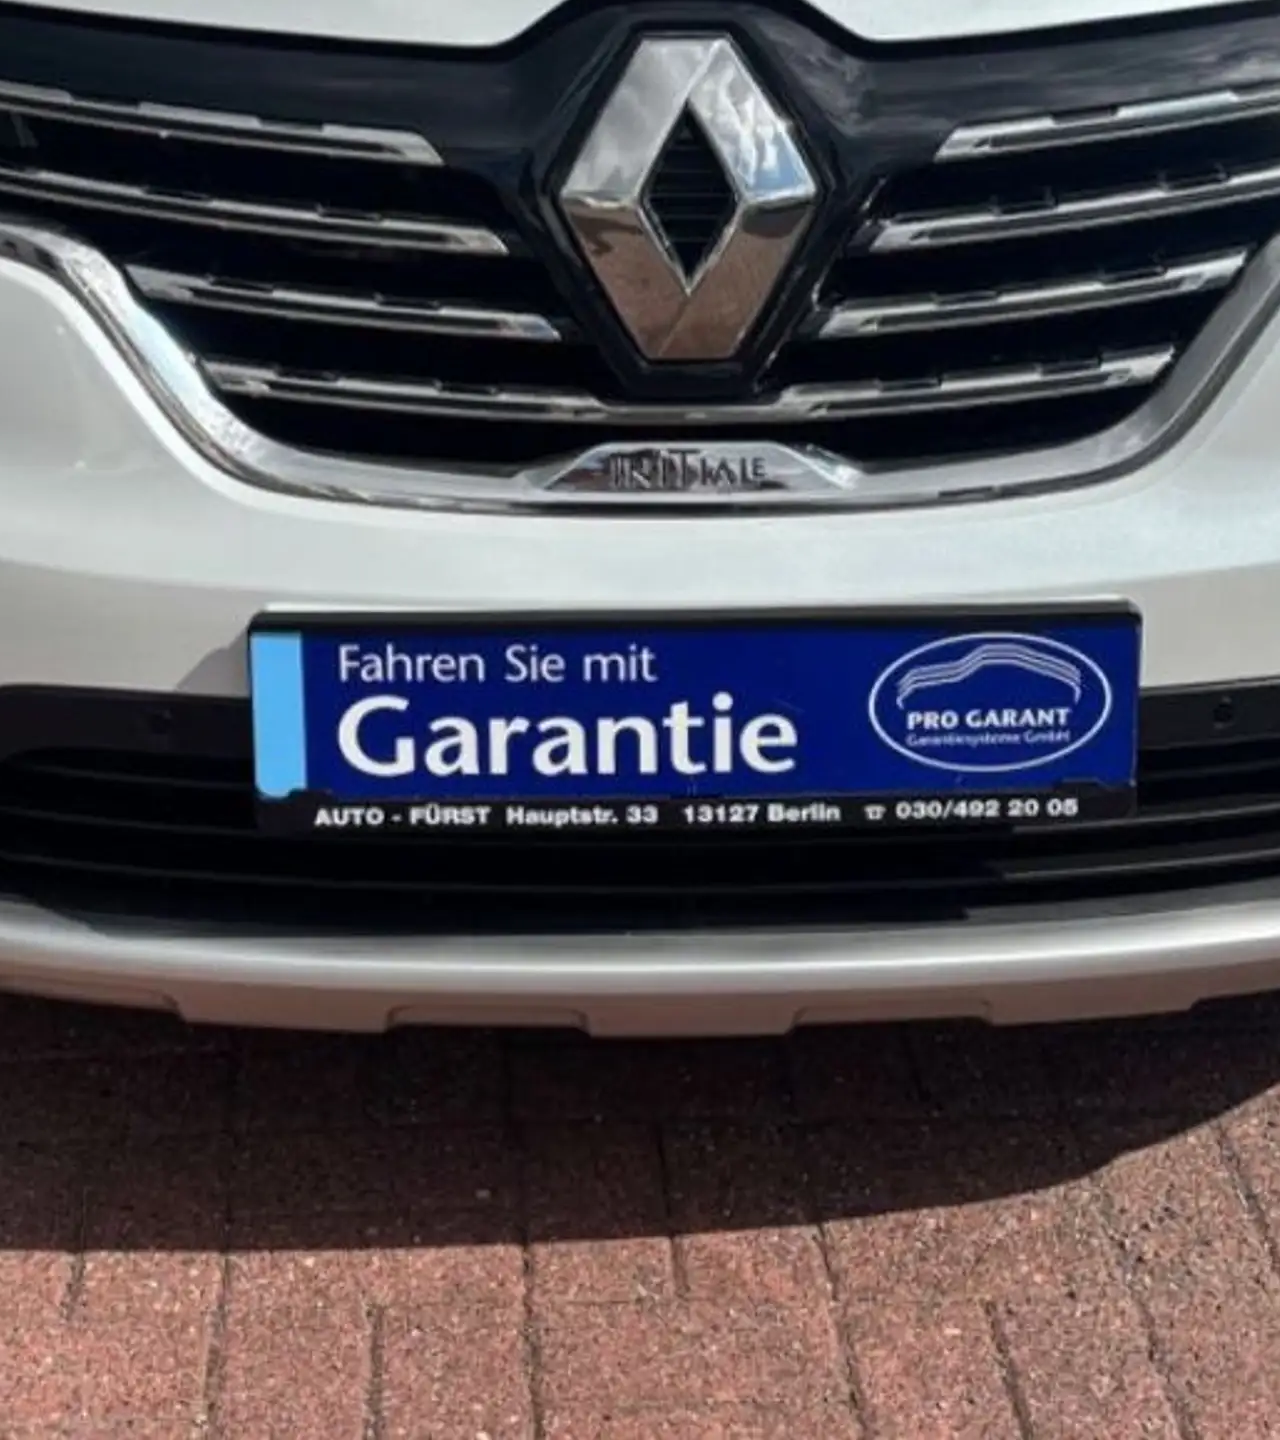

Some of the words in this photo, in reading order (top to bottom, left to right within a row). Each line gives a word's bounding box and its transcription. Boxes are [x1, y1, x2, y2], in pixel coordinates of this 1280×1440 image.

[338, 644, 485, 682] Fahren
[505, 644, 566, 682] Sie
[583, 644, 658, 682] mit
[337, 691, 799, 777] Garantie
[906, 710, 959, 730] PRO
[965, 707, 1072, 729] GARANT
[314, 807, 385, 827] AUTO
[410, 803, 491, 826] FÜRST
[505, 805, 619, 828] Hauptstr.
[627, 805, 659, 824] 33
[683, 804, 759, 823] 13127
[767, 802, 841, 822] Berlin
[895, 799, 1000, 819] 030/492
[1008, 798, 1039, 817] 20
[1047, 797, 1079, 816] 05
